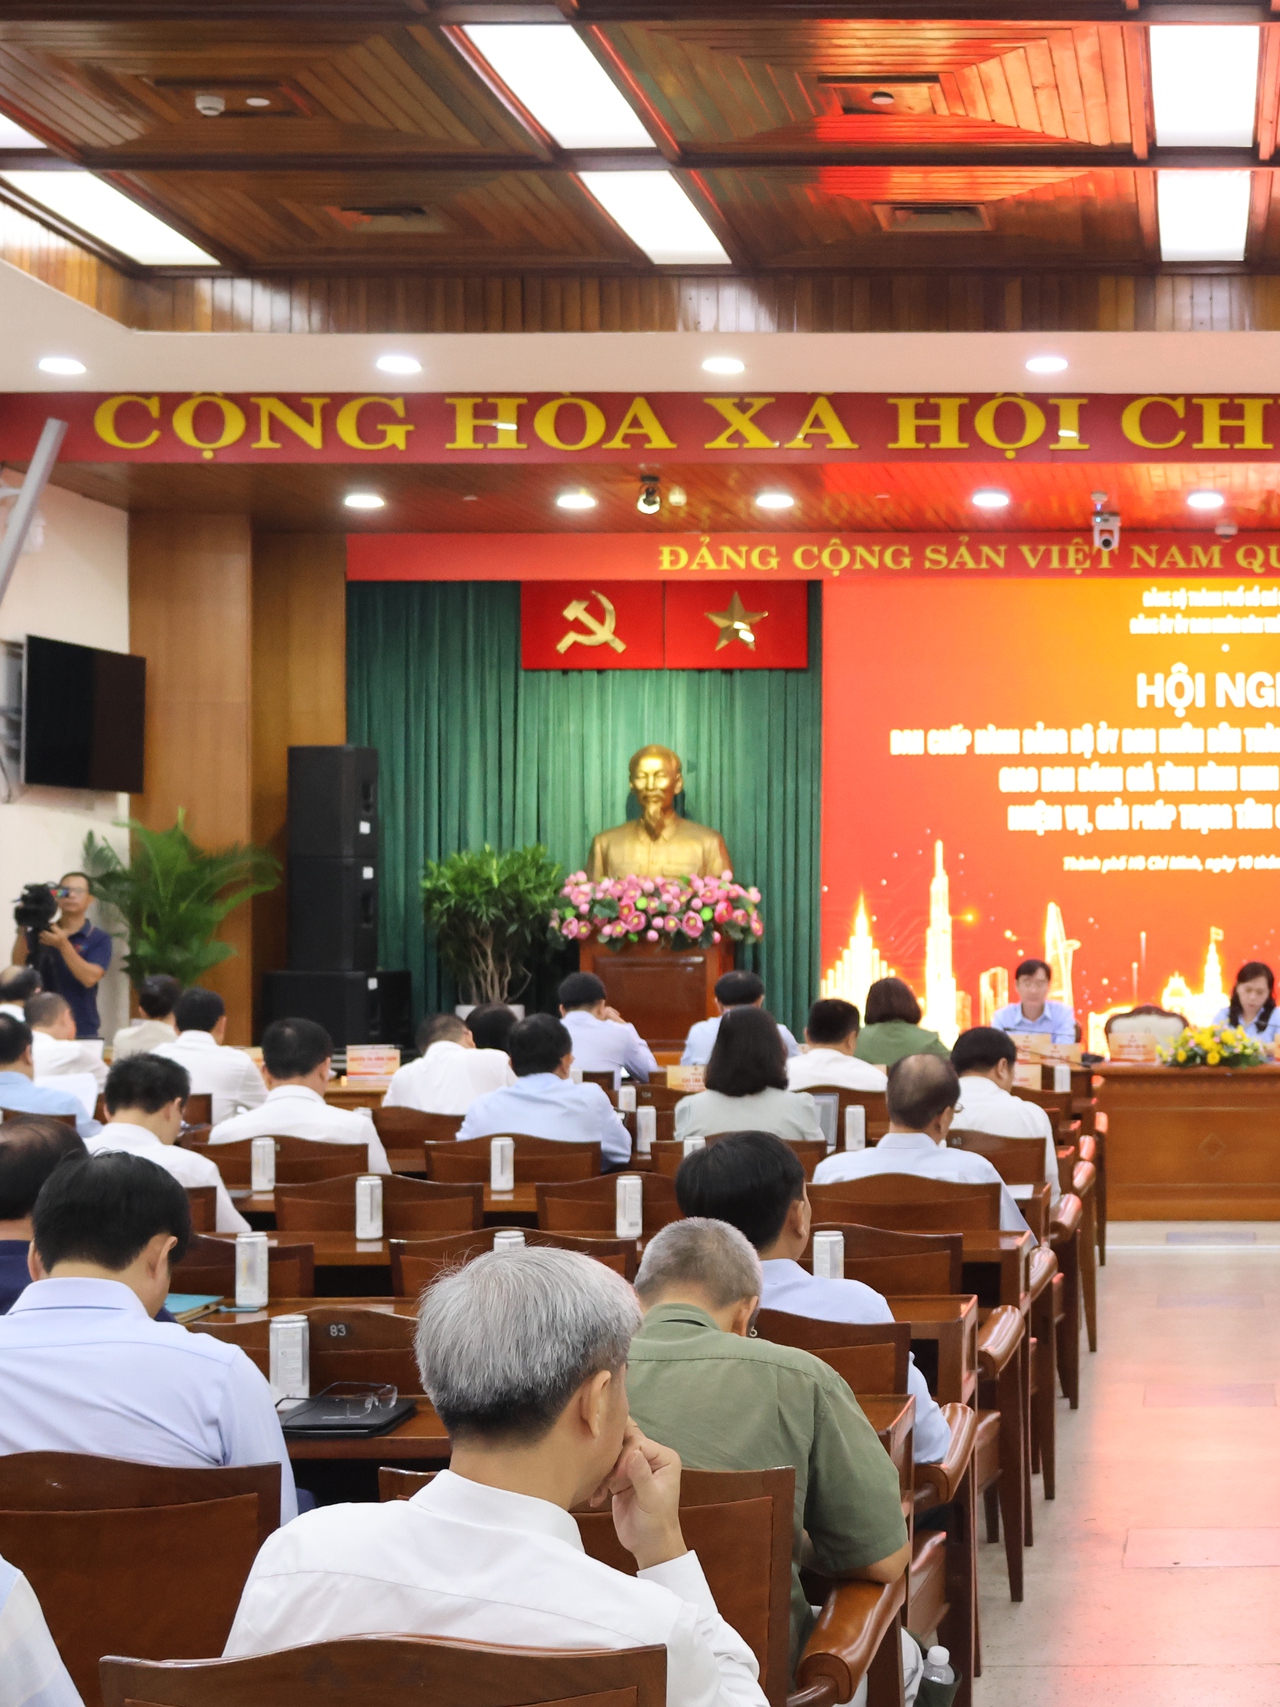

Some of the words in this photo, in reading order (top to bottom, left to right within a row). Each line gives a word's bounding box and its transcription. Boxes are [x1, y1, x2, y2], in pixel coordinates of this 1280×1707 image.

[658, 536, 780, 571] ĐẢNG
[791, 538, 911, 576] CỘNG
[924, 535, 1006, 569] SẢN
[1019, 537, 1118, 575] VIỆT
[1130, 545, 1223, 569] NAM
[1137, 663, 1206, 718] HỘI
[329, 1324, 347, 1337] 83
